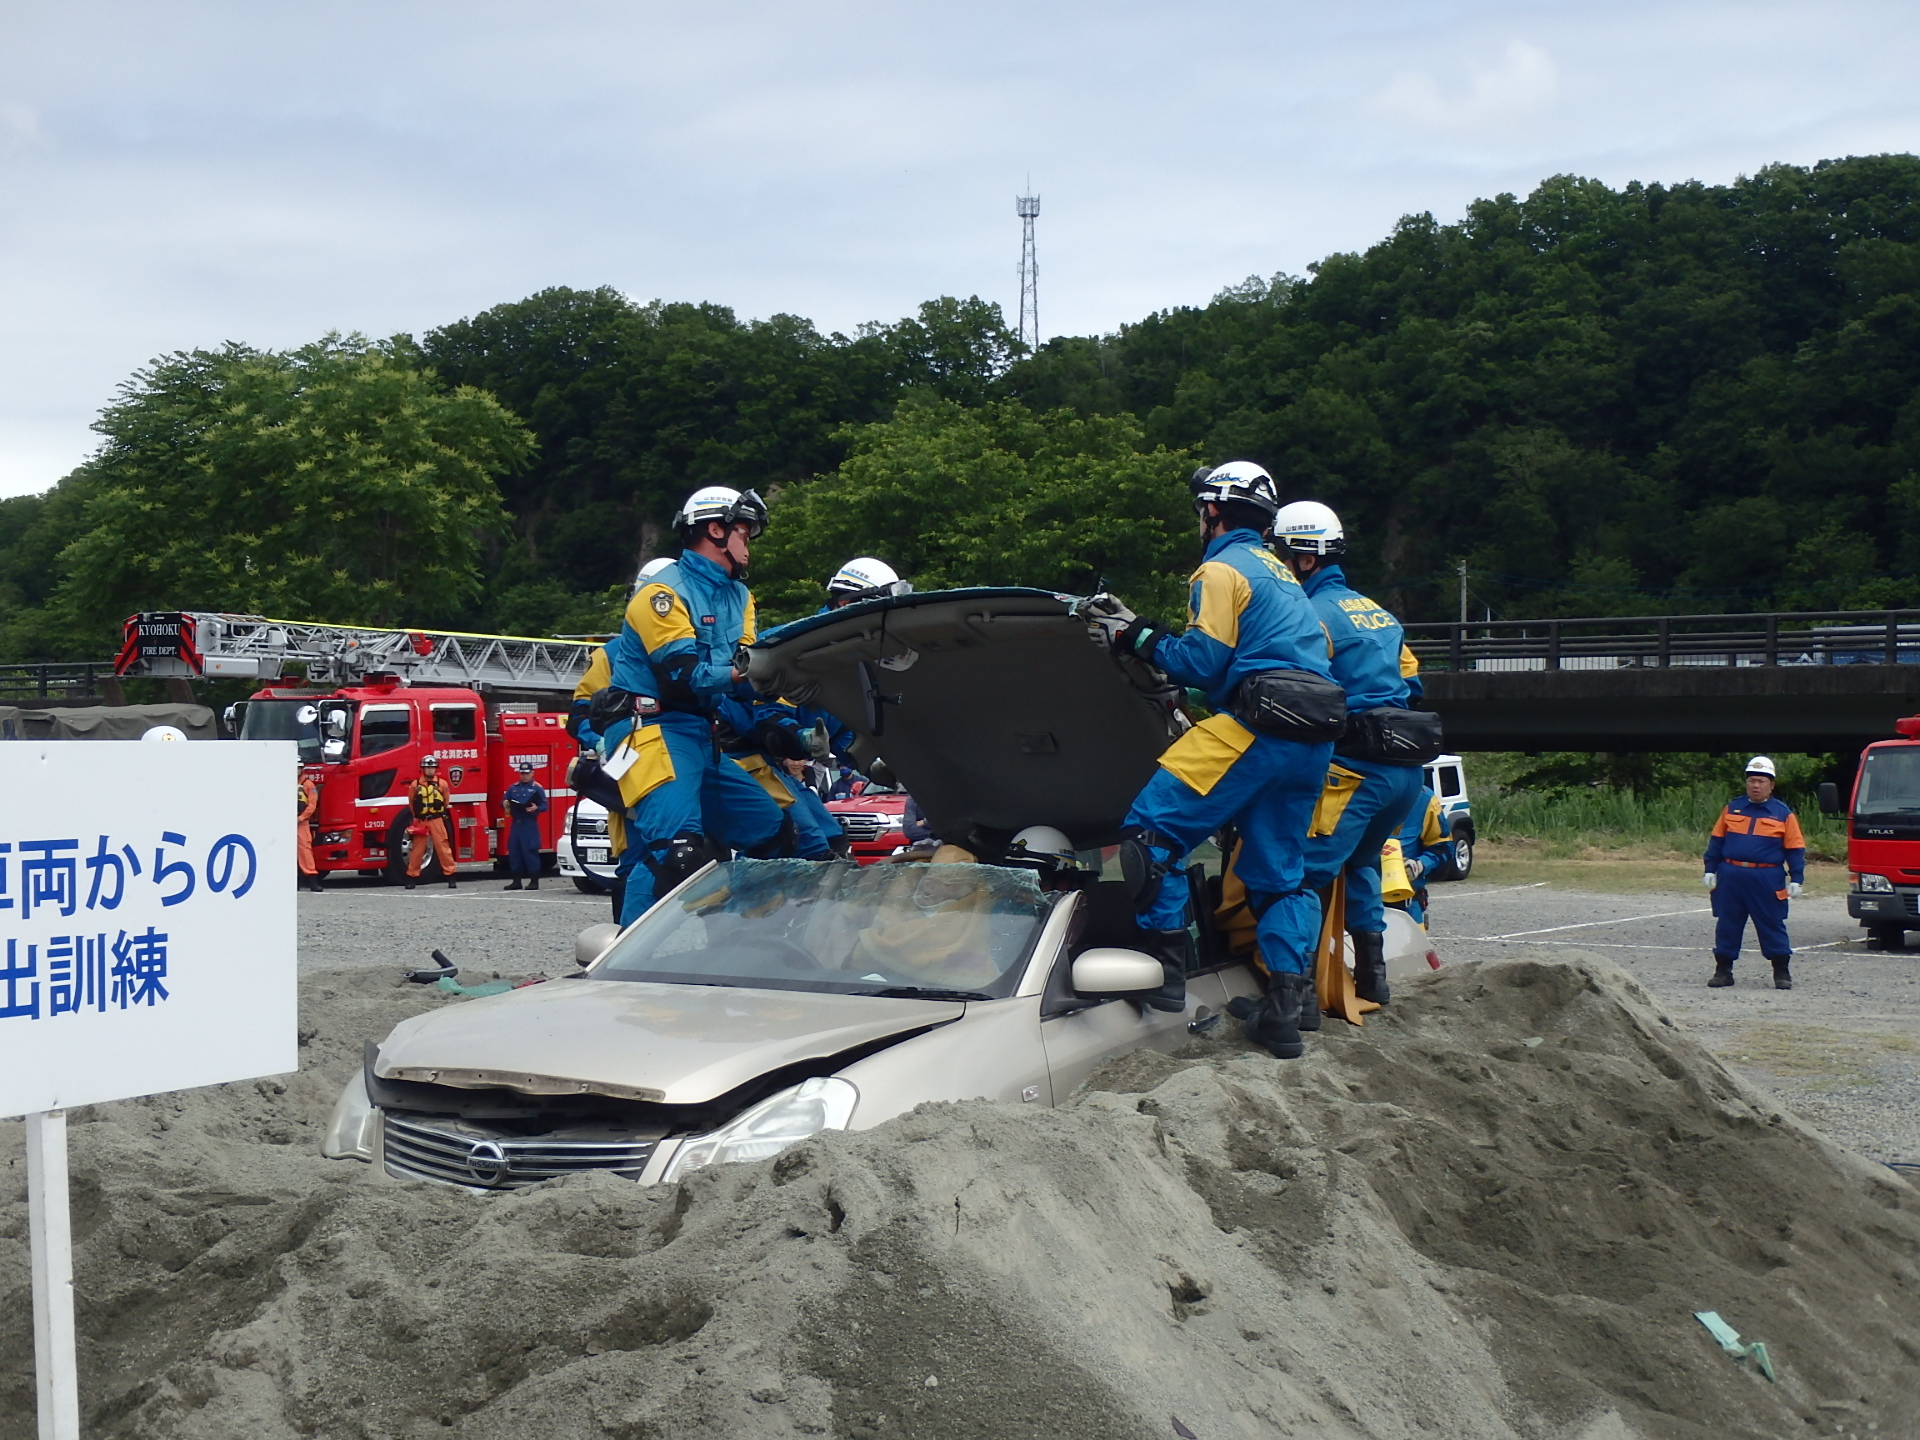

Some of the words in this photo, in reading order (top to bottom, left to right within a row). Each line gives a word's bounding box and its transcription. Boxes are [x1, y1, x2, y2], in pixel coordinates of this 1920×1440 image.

[1349, 612, 1396, 630] POLICE
[138, 623, 181, 636] KYOHOKU
[142, 646, 158, 655] FIRE
[159, 646, 178, 655] DEPT.
[508, 754, 549, 764] KYOHOKU
[364, 820, 385, 829] L2102
[0, 926, 170, 1021] 出訓練
[469, 1159, 500, 1169] NISSAN
